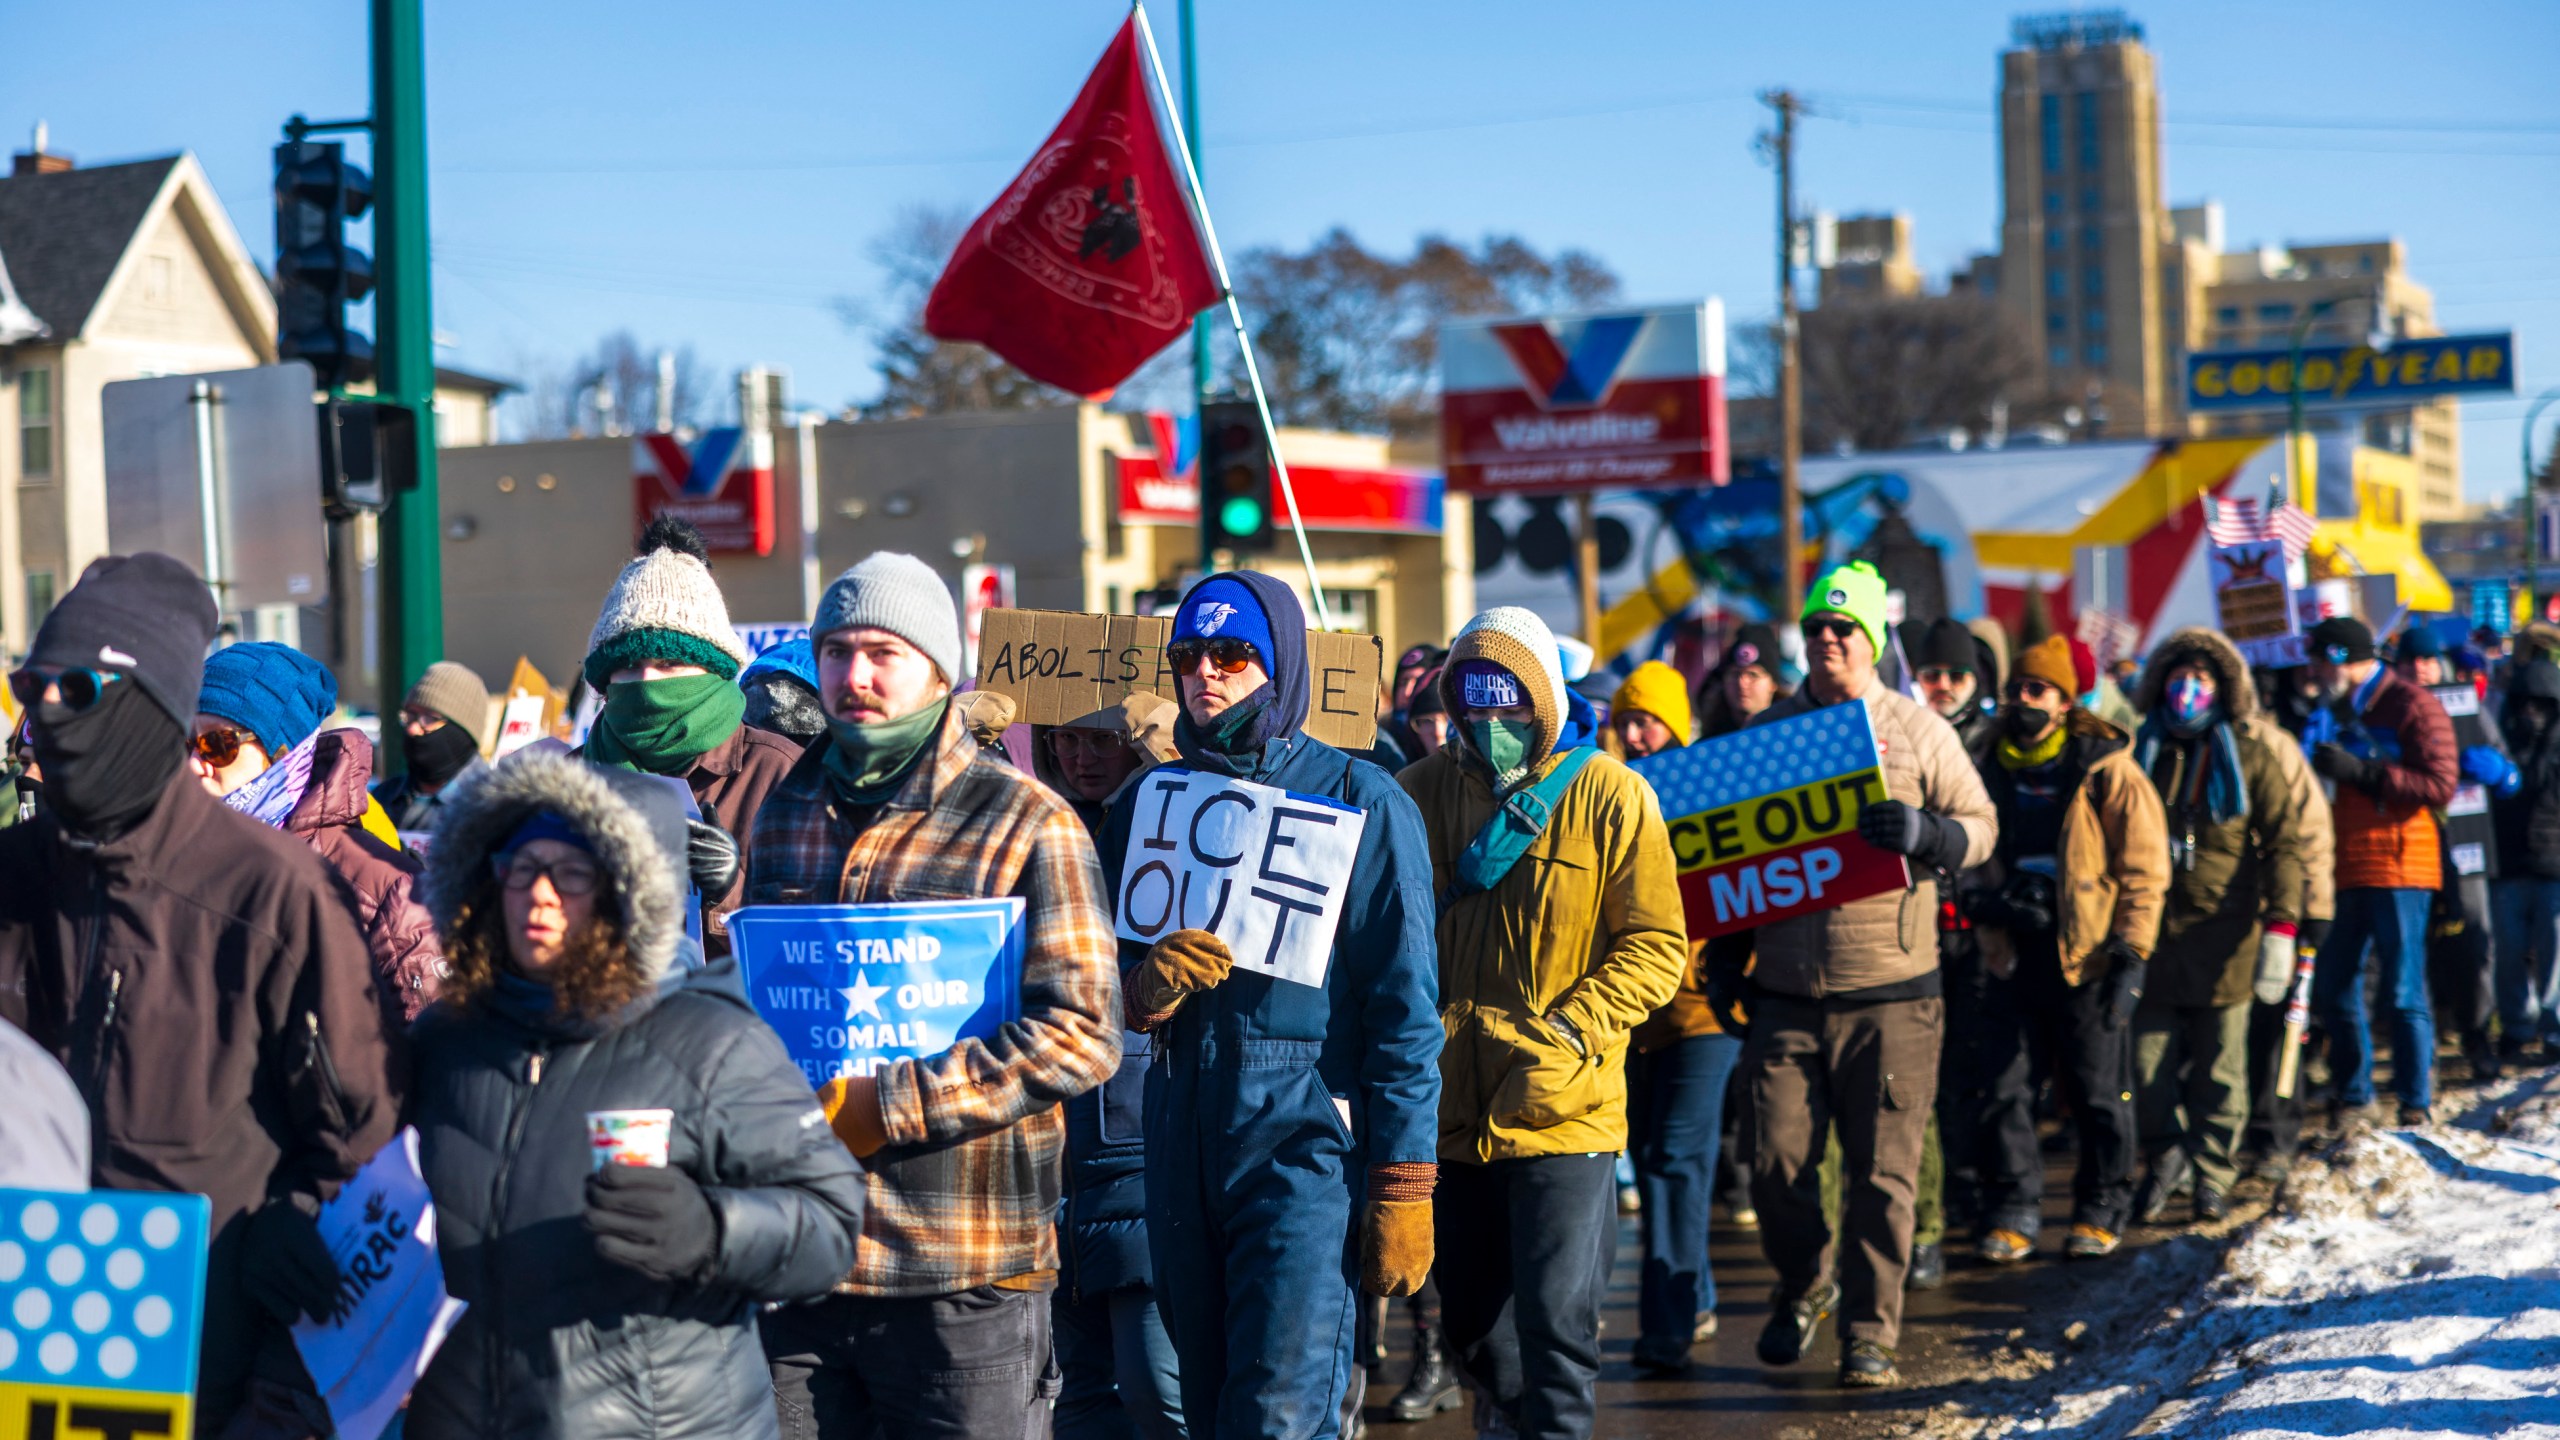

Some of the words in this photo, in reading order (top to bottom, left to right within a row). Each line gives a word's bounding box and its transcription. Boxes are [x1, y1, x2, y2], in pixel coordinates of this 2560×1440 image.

[1465, 673, 1516, 689] UNIONS
[1467, 688, 1486, 702] FOR
[1489, 689, 1518, 706] ALL
[233, 777, 268, 811] ouise
[1668, 809, 1745, 868] CE
[1755, 771, 1878, 847] OUT
[1143, 780, 1338, 896] ICE
[1707, 846, 1843, 924] MSP
[1124, 860, 1323, 965] OUT
[782, 940, 824, 964] WE
[836, 935, 941, 965] STAND
[767, 986, 831, 1010] WITH
[896, 979, 969, 1010] OUR
[810, 1020, 928, 1050] SOMALI
